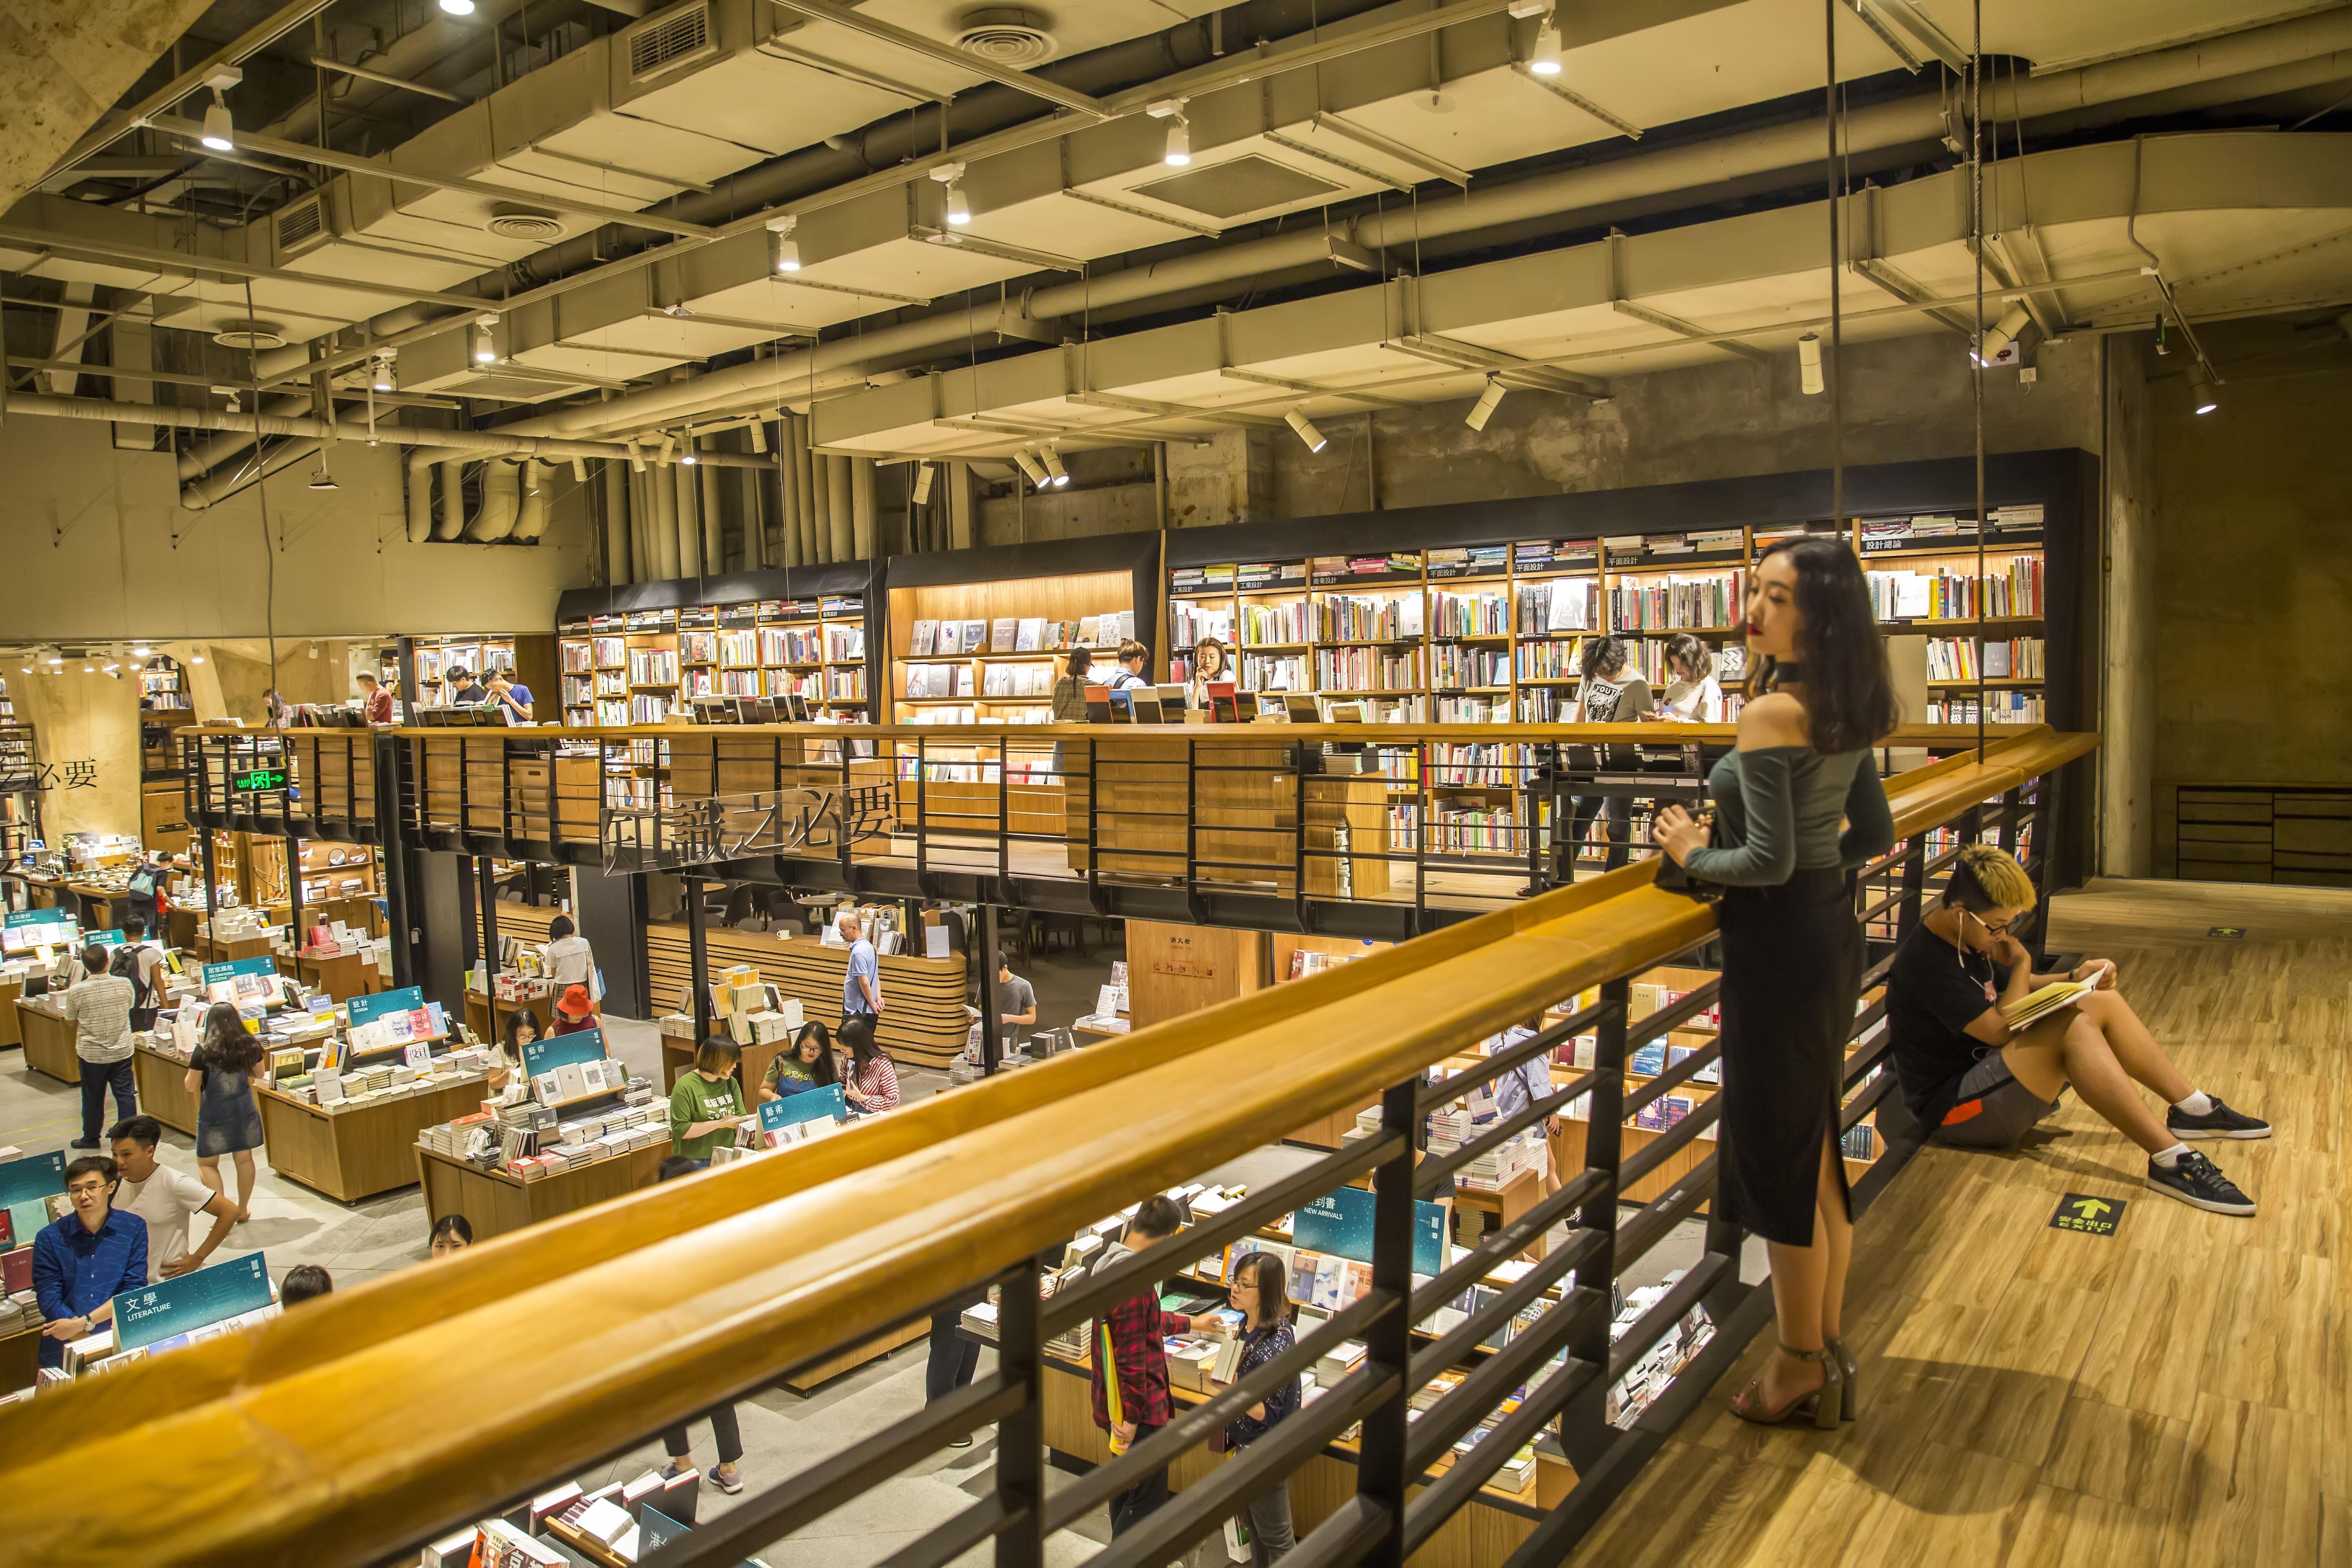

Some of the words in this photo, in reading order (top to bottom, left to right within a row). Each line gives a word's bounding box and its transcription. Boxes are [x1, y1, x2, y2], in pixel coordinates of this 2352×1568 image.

[1866, 539, 1902, 550] 設計總論
[1516, 562, 1544, 571] 平面設計
[1608, 557, 1637, 566] 平面設計
[1430, 568, 1456, 577] 平面設計
[601, 782, 893, 877] 知識之必要
[208, 965, 234, 974] 居家風格
[352, 999, 368, 1008] 設計
[409, 1047, 427, 1059] 设计
[528, 1045, 544, 1056] 藝術
[765, 1104, 783, 1117] 藝術
[1304, 1207, 1317, 1215] NEW
[1317, 1211, 1343, 1220] ARRIVALS
[2058, 1216, 2112, 1229] 安全出口
[2059, 1222, 2106, 1232] EXIT
[125, 1292, 158, 1313] 文學
[128, 1302, 172, 1322] LITERATURE
